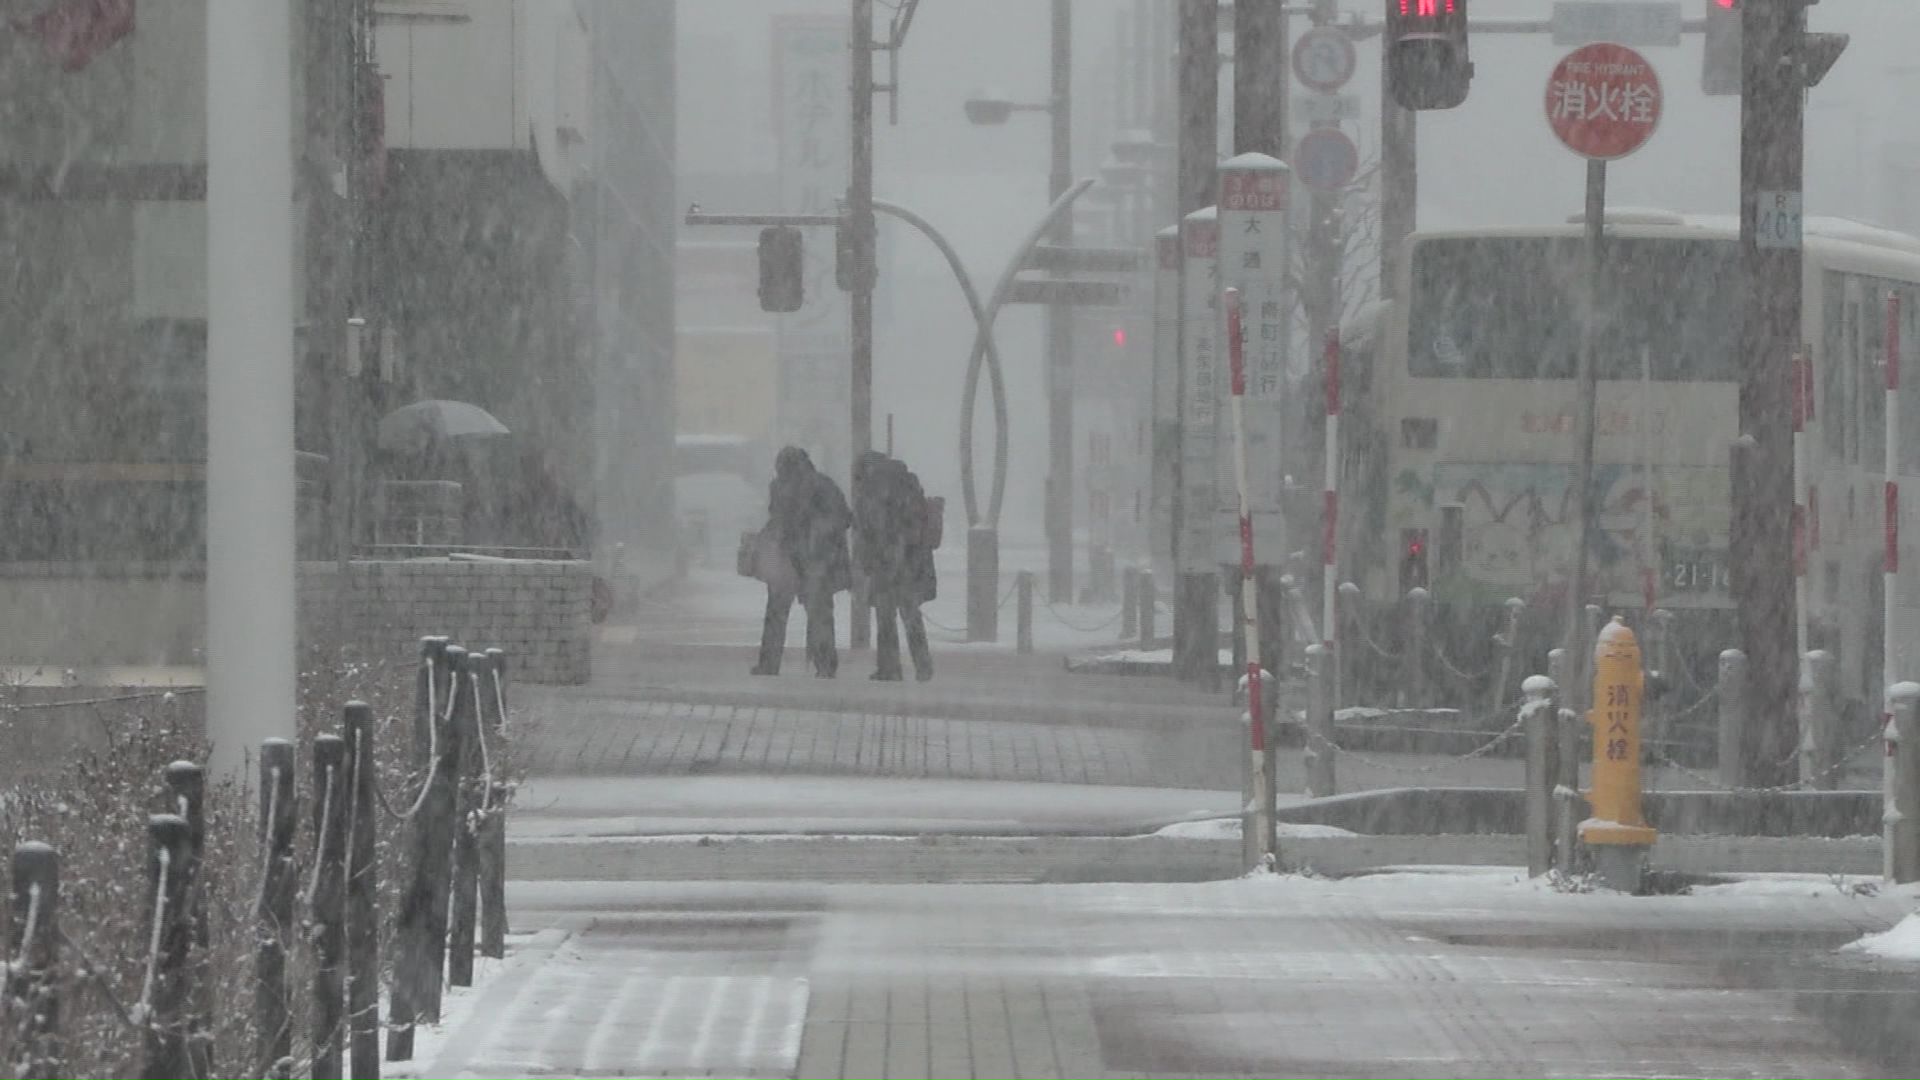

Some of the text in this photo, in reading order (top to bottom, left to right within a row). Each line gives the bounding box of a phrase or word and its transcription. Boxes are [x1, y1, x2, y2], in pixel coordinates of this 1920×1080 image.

[1566, 62, 1645, 76] FIRE HYDRANT
[1551, 80, 1655, 122] 消火栓
[1605, 683, 1632, 761] 消火栓
